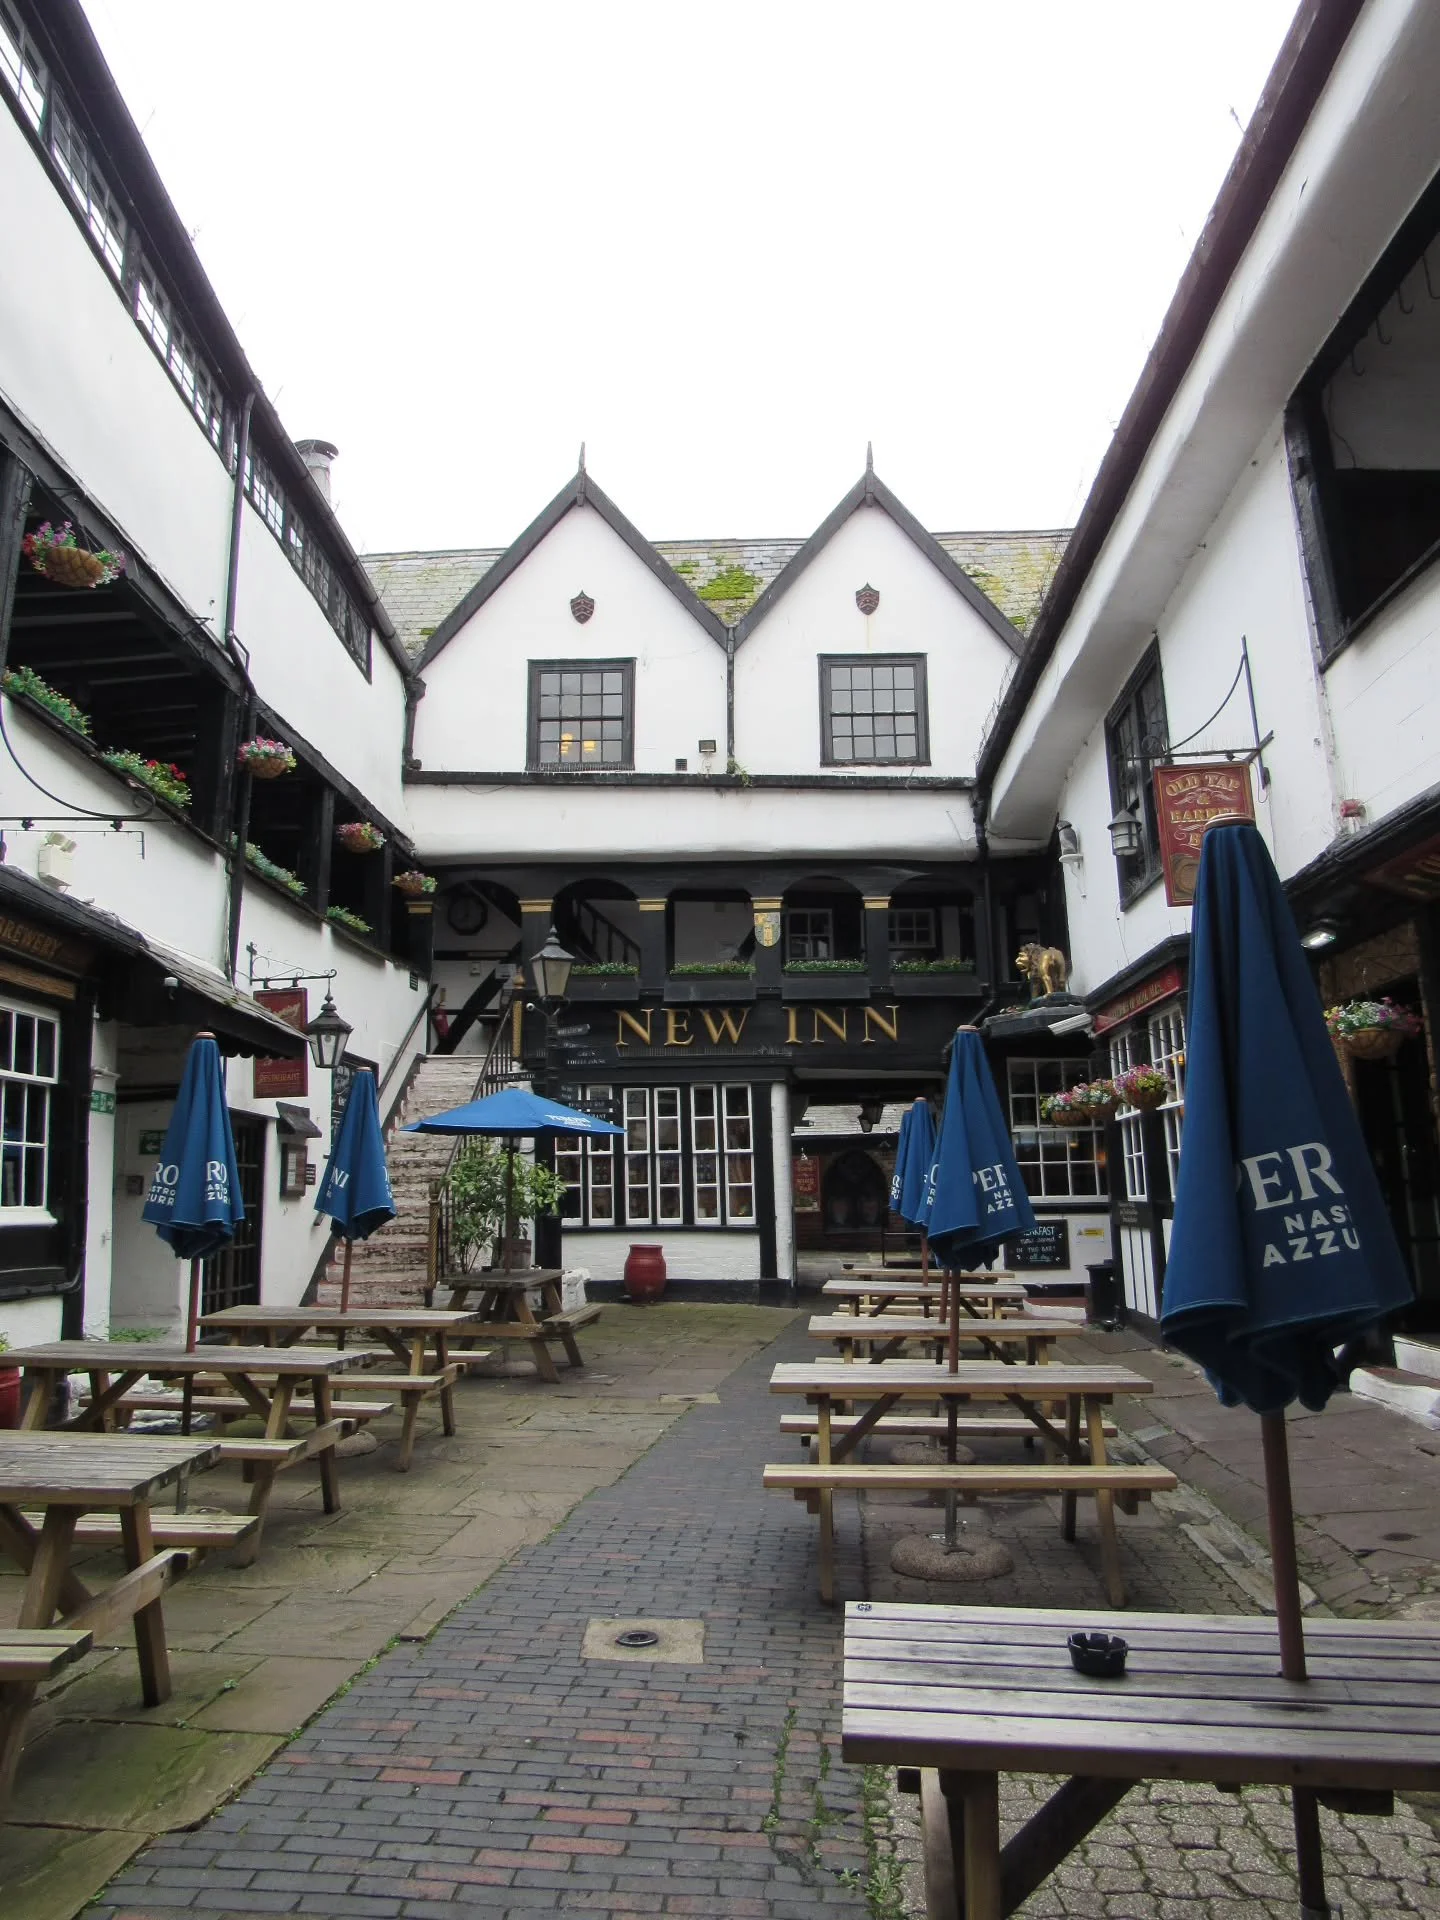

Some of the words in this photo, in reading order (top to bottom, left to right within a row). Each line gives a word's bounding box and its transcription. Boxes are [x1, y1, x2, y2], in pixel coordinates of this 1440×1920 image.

[1165, 775, 1201, 797] OLD
[1204, 774, 1240, 792] TAP
[613, 1007, 752, 1047] NEW
[781, 1005, 900, 1044] INN
[149, 1185, 177, 1197] STRO
[1239, 1142, 1344, 1211] ER
[994, 1189, 1012, 1200] NA
[1283, 1204, 1353, 1234] NAS
[1262, 1228, 1361, 1268] AZZU
